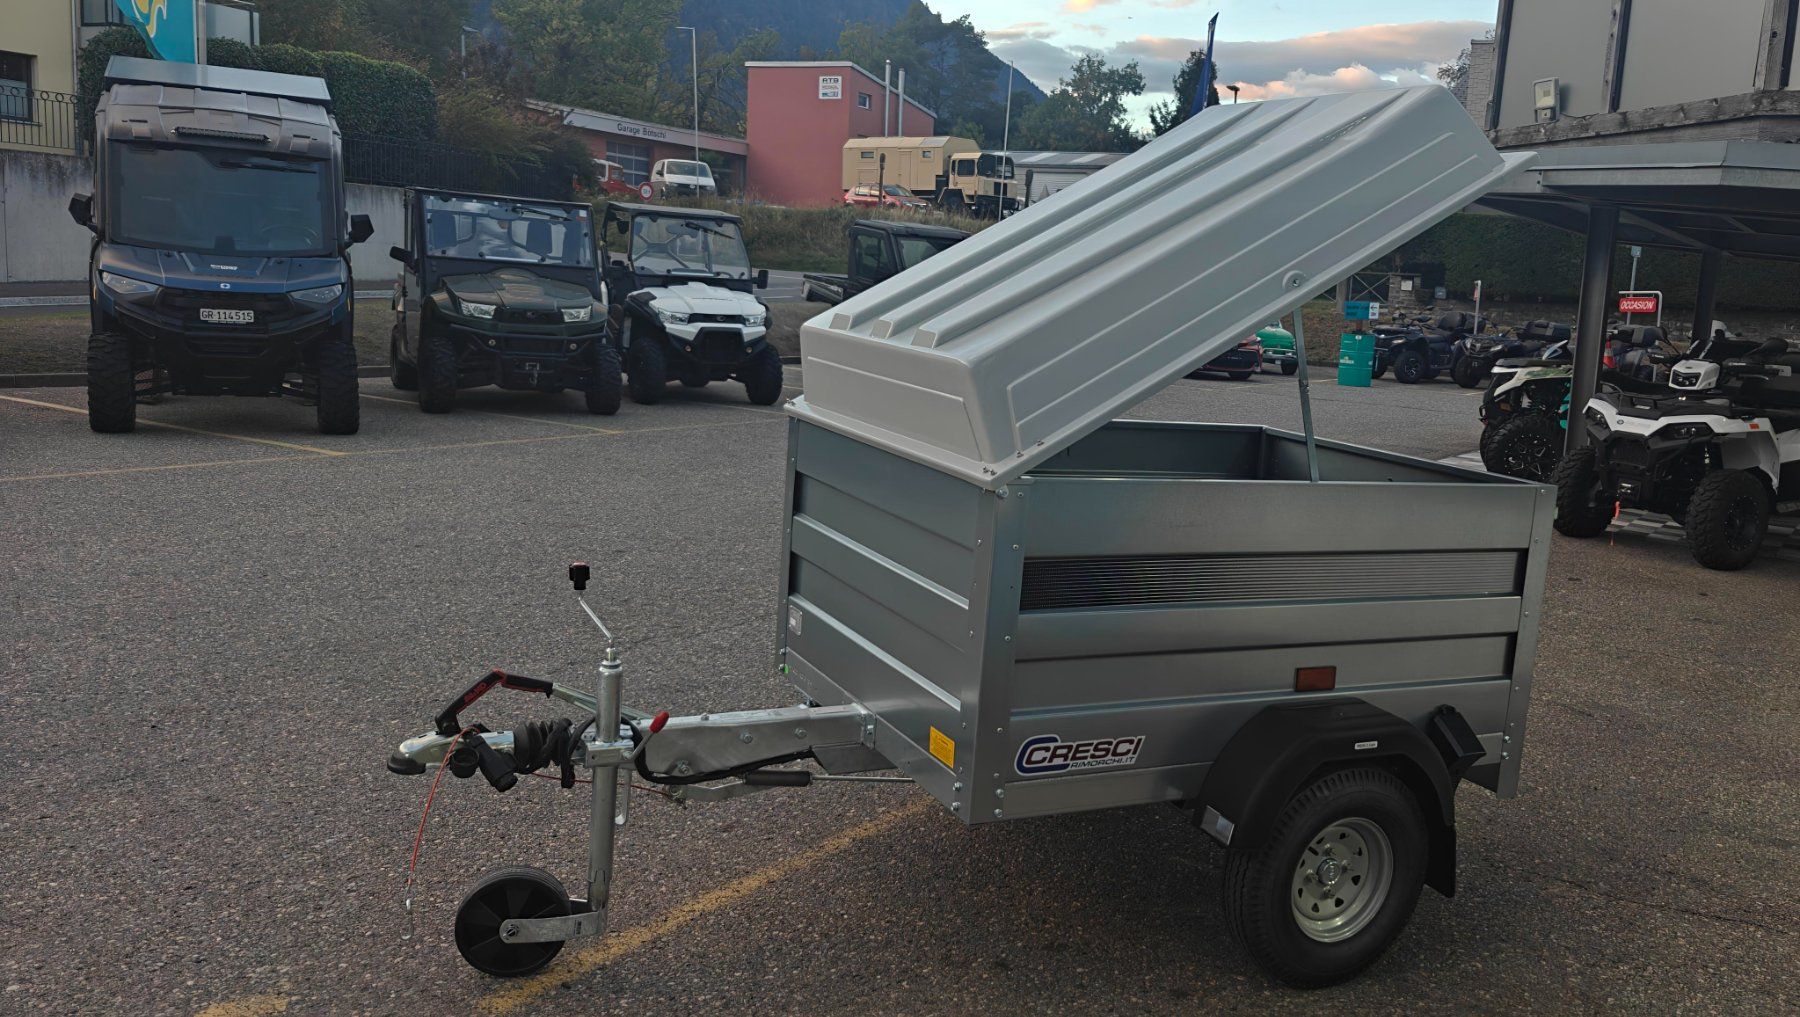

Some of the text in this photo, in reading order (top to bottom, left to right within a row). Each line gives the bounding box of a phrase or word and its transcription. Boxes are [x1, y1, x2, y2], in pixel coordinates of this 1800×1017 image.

[617, 122, 641, 136] Garage
[1620, 300, 1655, 310] OCCASION
[1022, 736, 1144, 767] CRESCI
